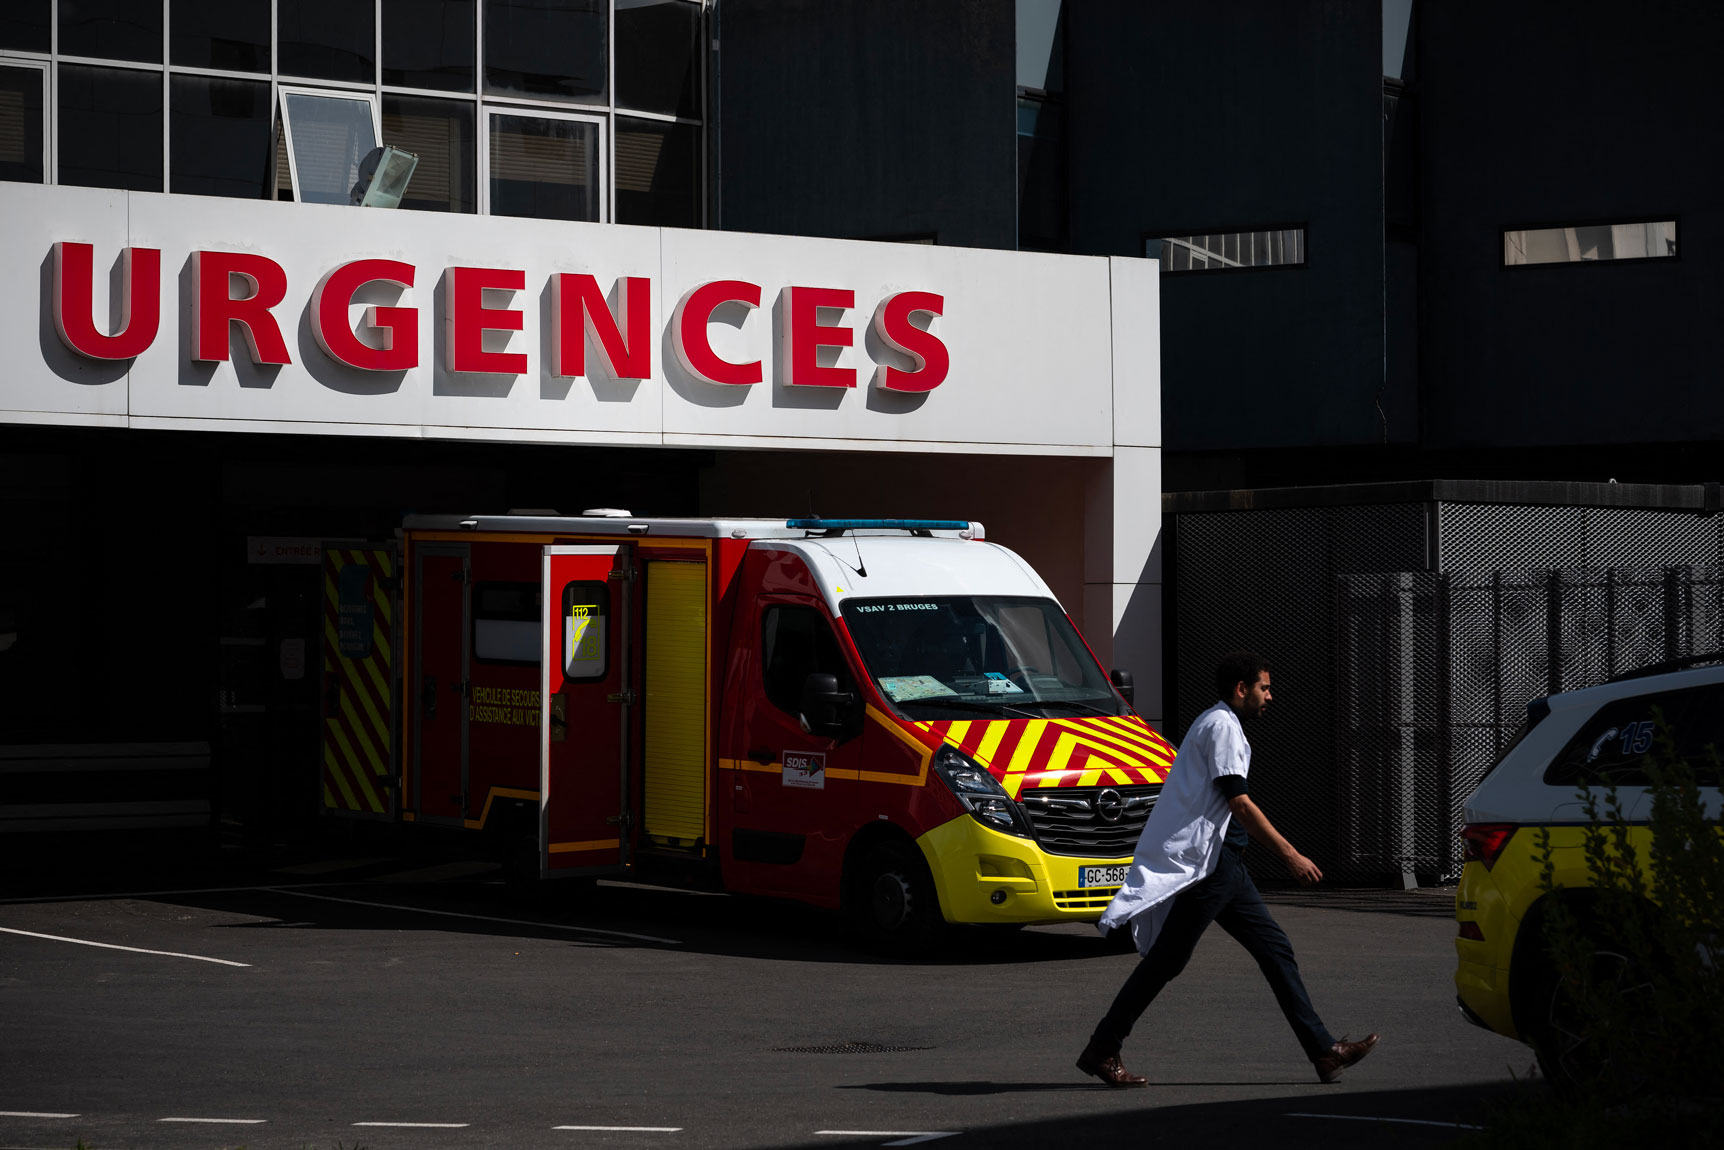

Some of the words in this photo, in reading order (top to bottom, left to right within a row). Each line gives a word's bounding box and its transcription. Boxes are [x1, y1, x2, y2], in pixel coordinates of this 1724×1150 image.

[53, 242, 949, 394] URGENCES
[574, 607, 589, 620] 112
[856, 605, 884, 613] VSAV
[897, 603, 938, 611] BRUGES
[580, 636, 597, 657] 18
[502, 688, 511, 706] DE
[511, 689, 540, 707] SECOURS
[512, 708, 524, 726] AUX
[1620, 720, 1656, 755] 15
[786, 757, 808, 769] SDIS
[1087, 867, 1131, 884] GC-568-
